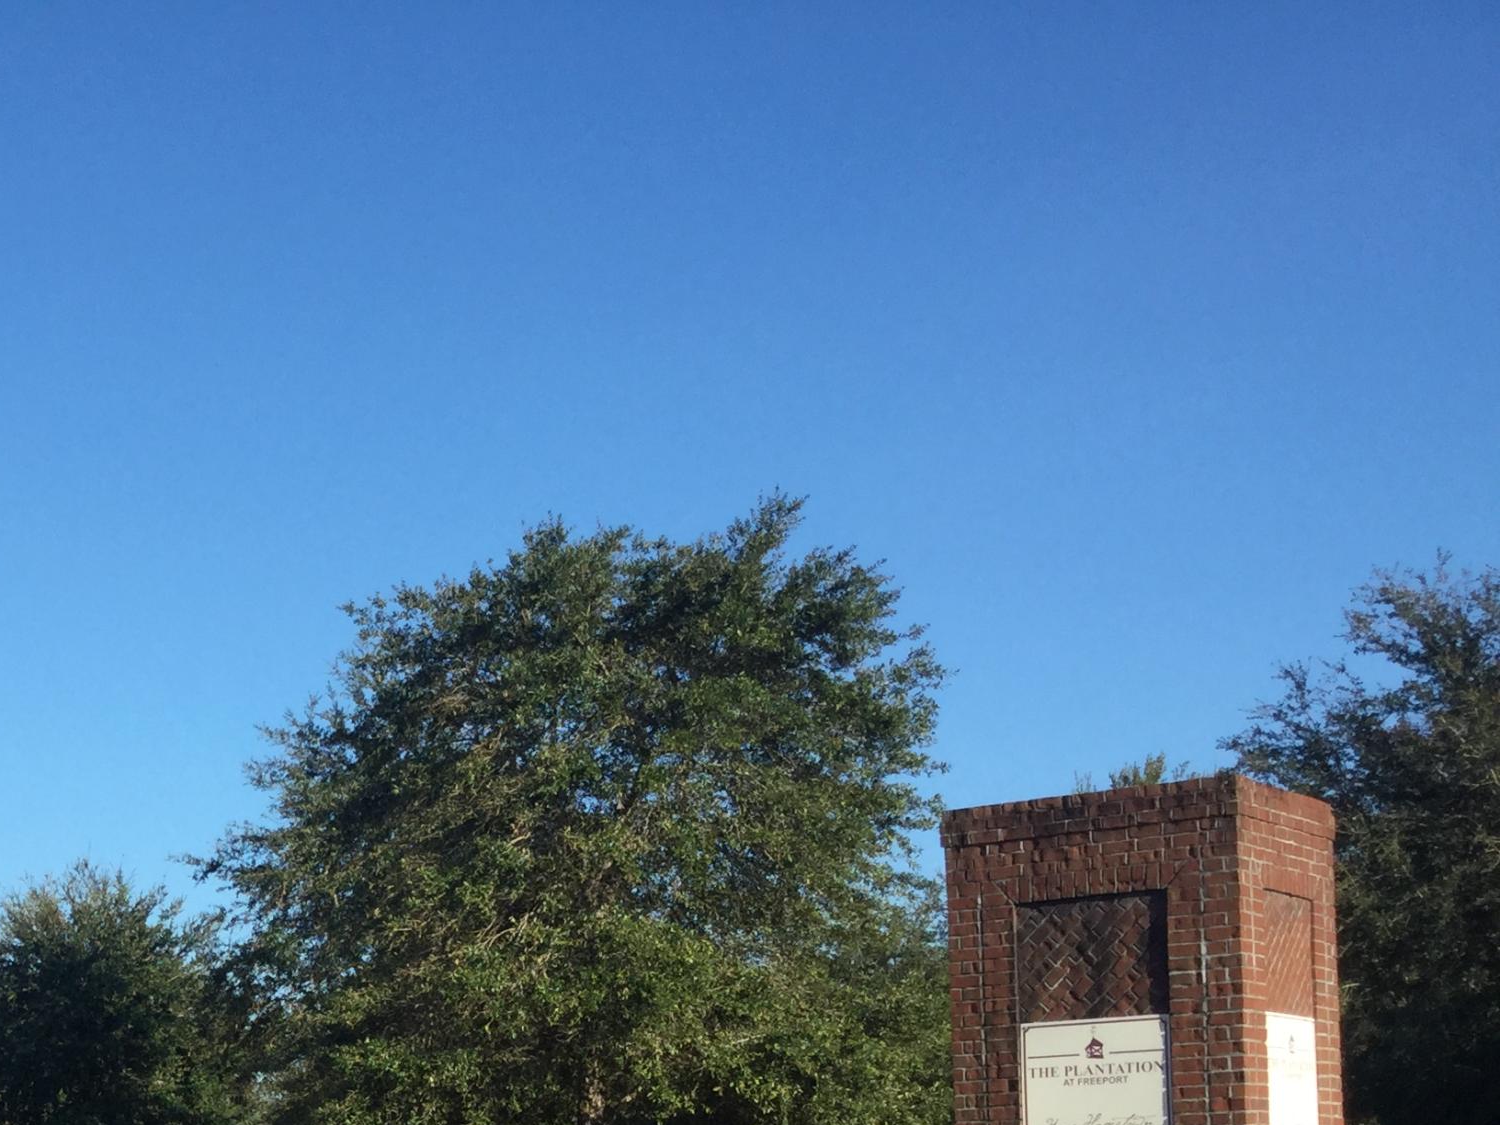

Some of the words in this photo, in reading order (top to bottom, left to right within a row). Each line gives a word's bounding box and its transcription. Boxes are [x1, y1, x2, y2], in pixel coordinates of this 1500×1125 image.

[1029, 1067, 1059, 1079] THE
[1065, 1060, 1164, 1077] PLANTATION
[1063, 1078, 1074, 1087] AT
[1077, 1075, 1129, 1086] FREEPORT
